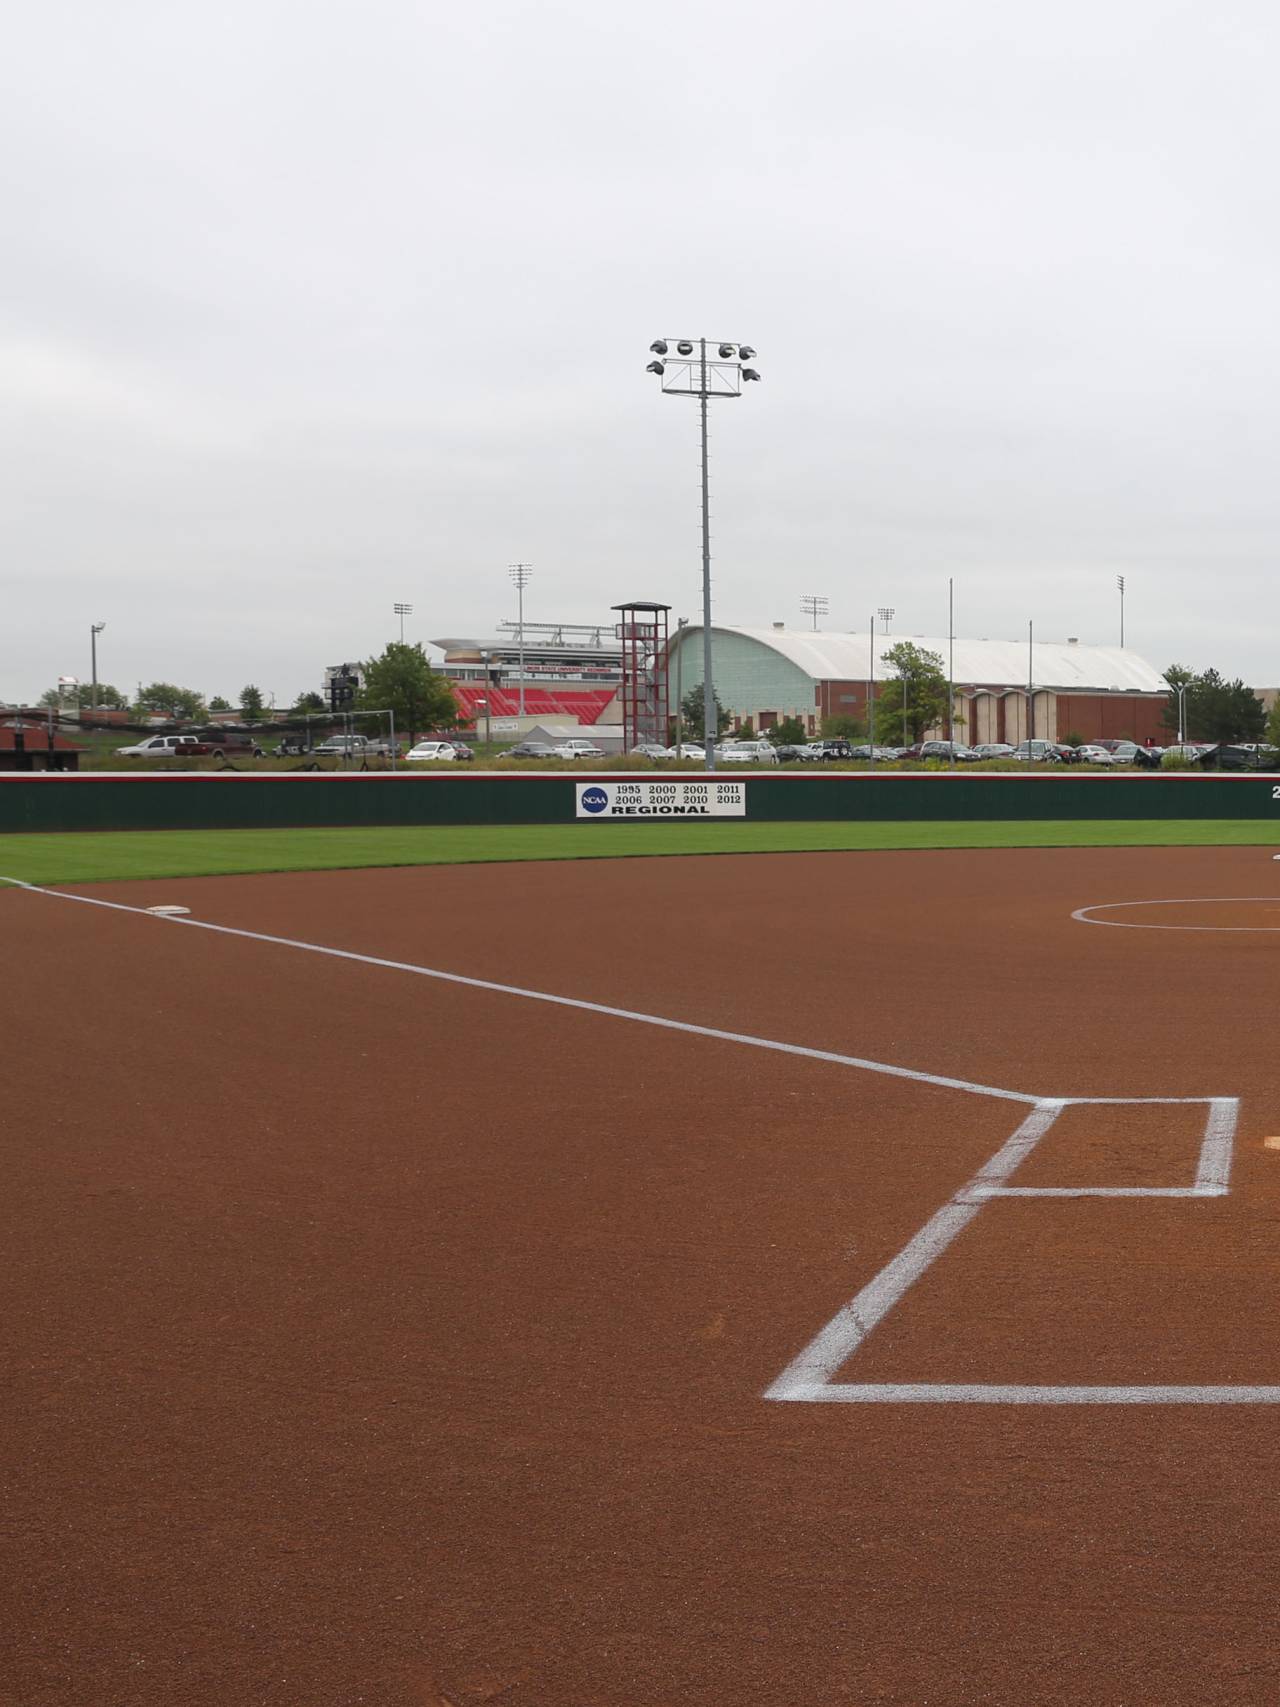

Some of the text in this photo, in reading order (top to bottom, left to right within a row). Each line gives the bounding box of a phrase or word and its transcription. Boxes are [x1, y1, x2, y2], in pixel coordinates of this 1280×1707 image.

[649, 785, 676, 794] 2000
[683, 785, 708, 794] 2001
[717, 785, 739, 793] 2011
[616, 795, 741, 804] 2006 2007 2010 2012
[612, 806, 710, 814] REGIONAL
